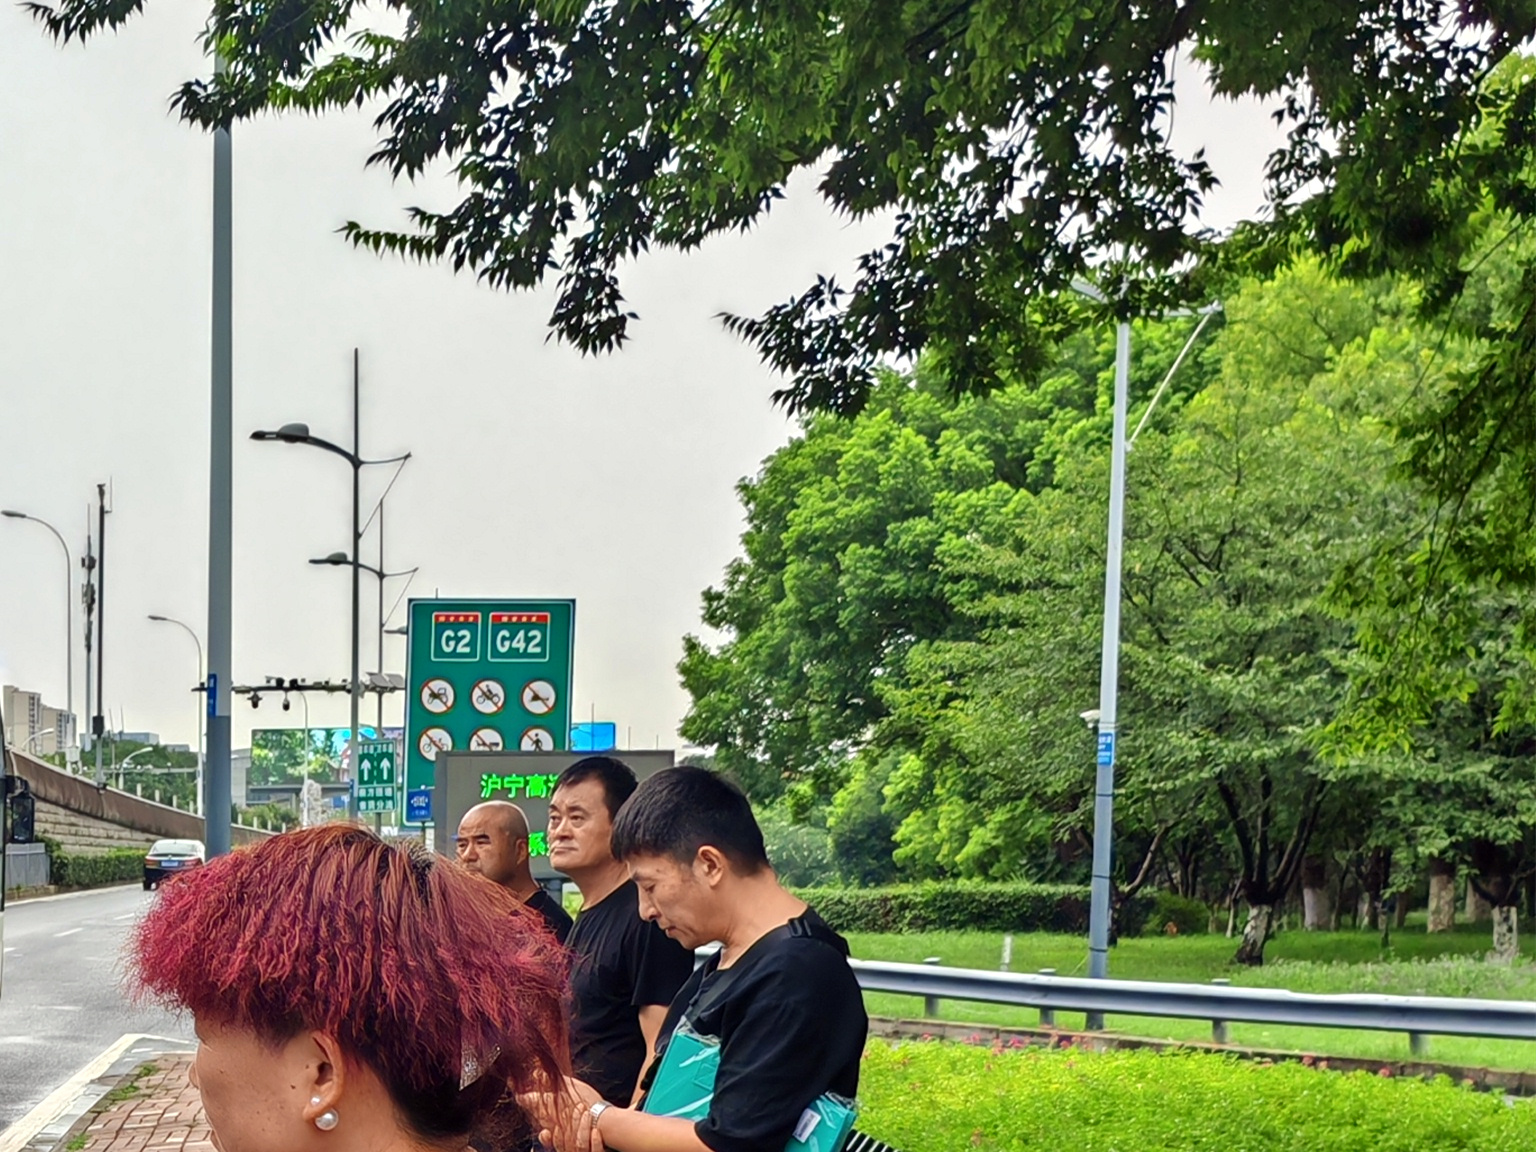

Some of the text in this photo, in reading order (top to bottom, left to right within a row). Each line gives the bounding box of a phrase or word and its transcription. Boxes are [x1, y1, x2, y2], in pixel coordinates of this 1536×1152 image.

[441, 629, 471, 653] G2
[496, 629, 542, 653] G42
[480, 773, 558, 799] 沪宁高
[528, 831, 551, 857] 系
